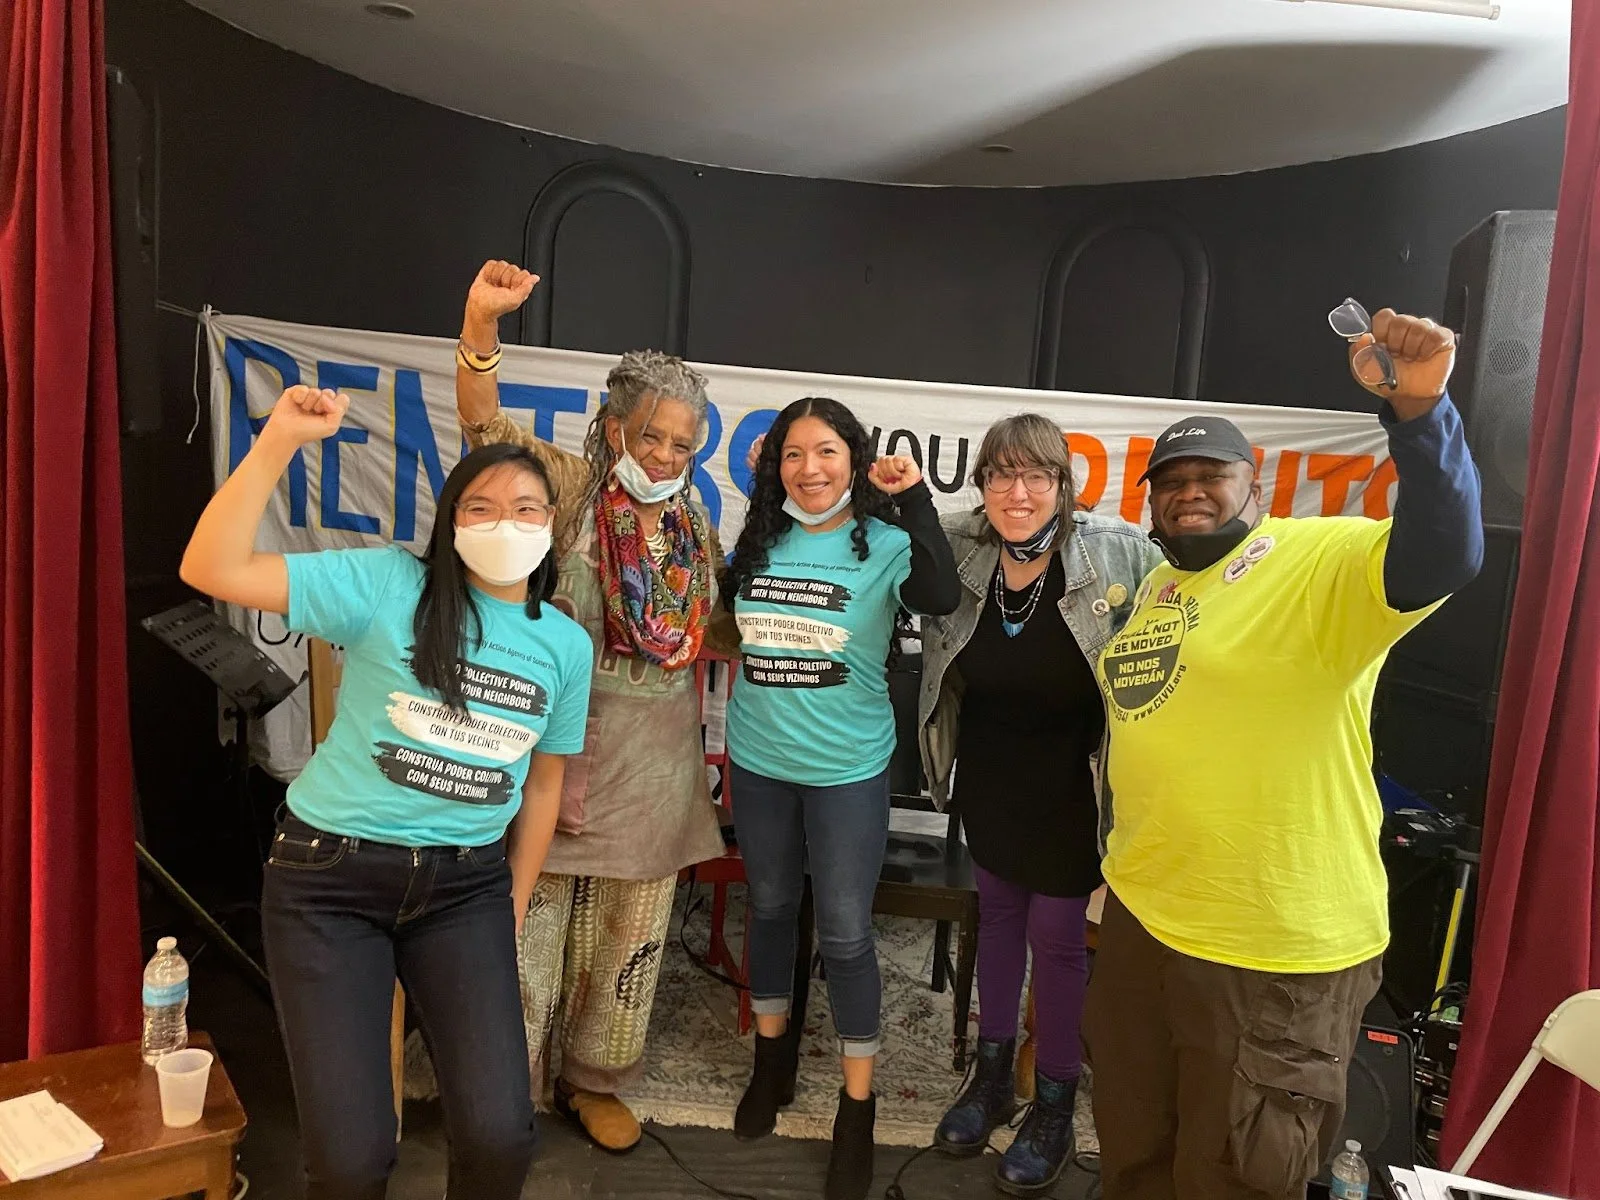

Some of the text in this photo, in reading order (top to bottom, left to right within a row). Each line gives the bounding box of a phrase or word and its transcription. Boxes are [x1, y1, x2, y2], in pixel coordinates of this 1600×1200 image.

[1166, 428, 1206, 441] Dad Life
[751, 577, 834, 594] BUILD COLLECTIVE POWER
[750, 588, 828, 606] WITH YOUR NEIGHBORS
[773, 619, 795, 629] PODER
[796, 621, 834, 636] COLECTIVO
[1152, 620, 1180, 635] NOT
[755, 630, 812, 644] CON TUS VECINES
[1114, 642, 1129, 654] BE
[1130, 634, 1173, 651] MOVED
[488, 641, 507, 653] Action
[507, 647, 526, 661] Agency
[526, 654, 532, 662] of
[745, 655, 832, 672] CONSTRUA PODER COLETIVO
[1118, 656, 1161, 674] NO NOS
[752, 670, 820, 684] COM SEUS VIZINHOS
[1113, 668, 1165, 690] MOVERÁN
[460, 681, 532, 710] YOUR NEIGHBORS
[509, 679, 536, 696] POWER
[408, 700, 530, 742] CONSTRUYE PODER COLECTIVO
[429, 723, 501, 751] CON TUS VECINES
[395, 748, 503, 784] CONSTRUA PODER COLIVO
[406, 769, 489, 799] COM SEUS VIZINHOS
